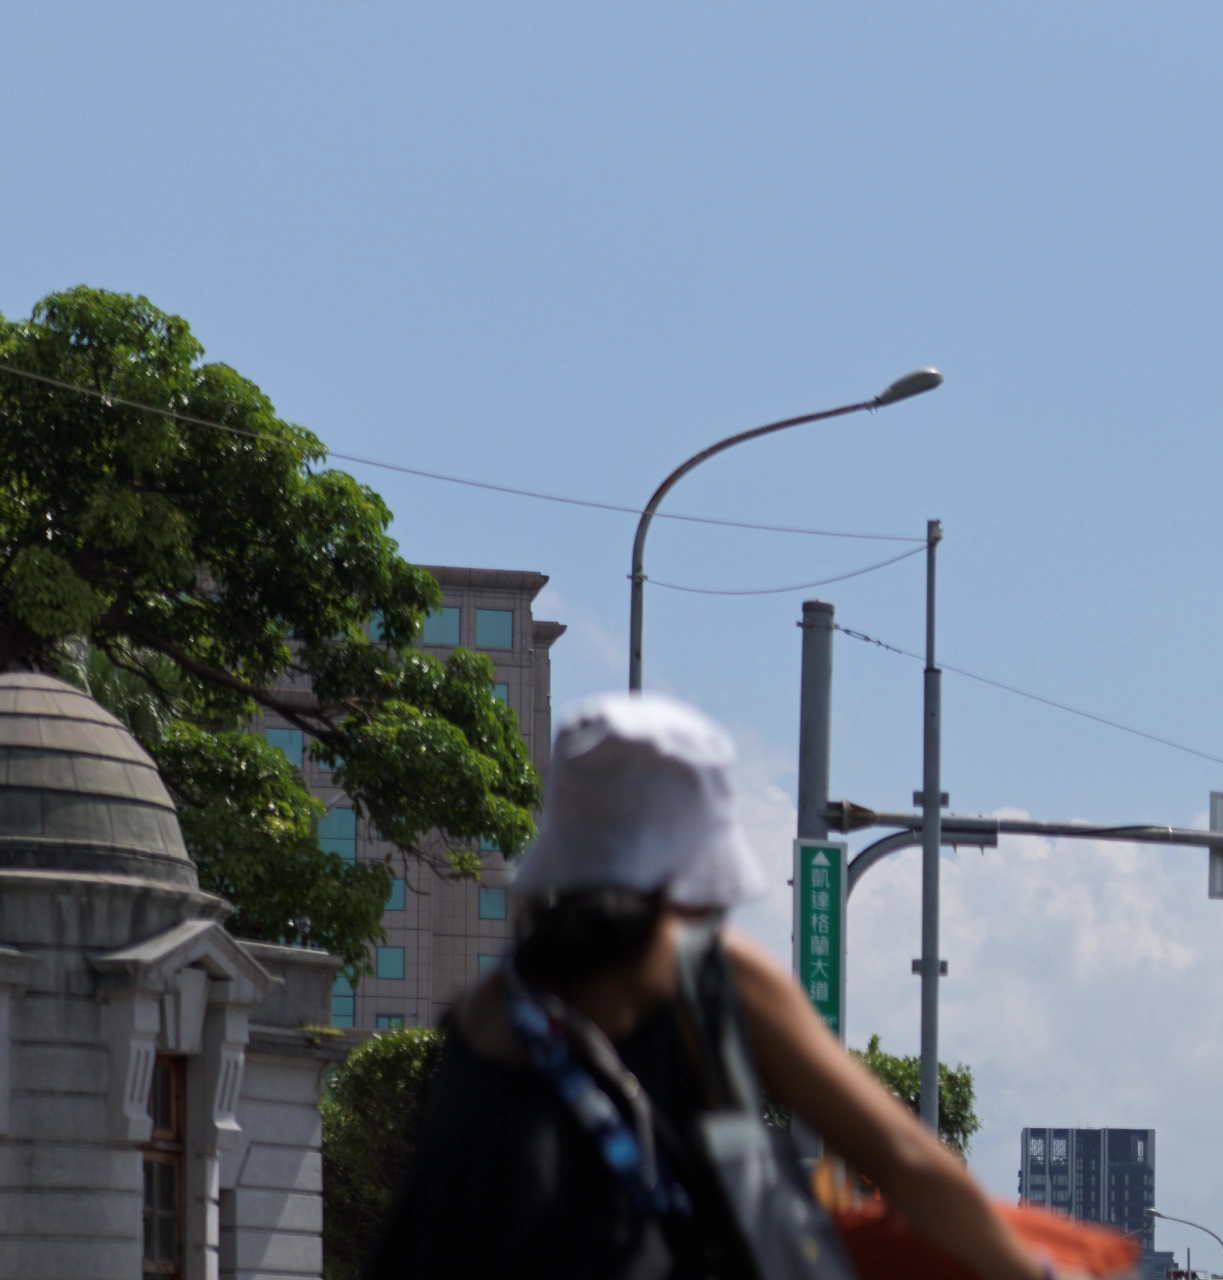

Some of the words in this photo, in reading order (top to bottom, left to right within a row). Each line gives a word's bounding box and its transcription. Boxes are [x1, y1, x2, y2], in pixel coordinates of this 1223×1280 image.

[810, 868, 831, 1001] 凱達格蘭大道
